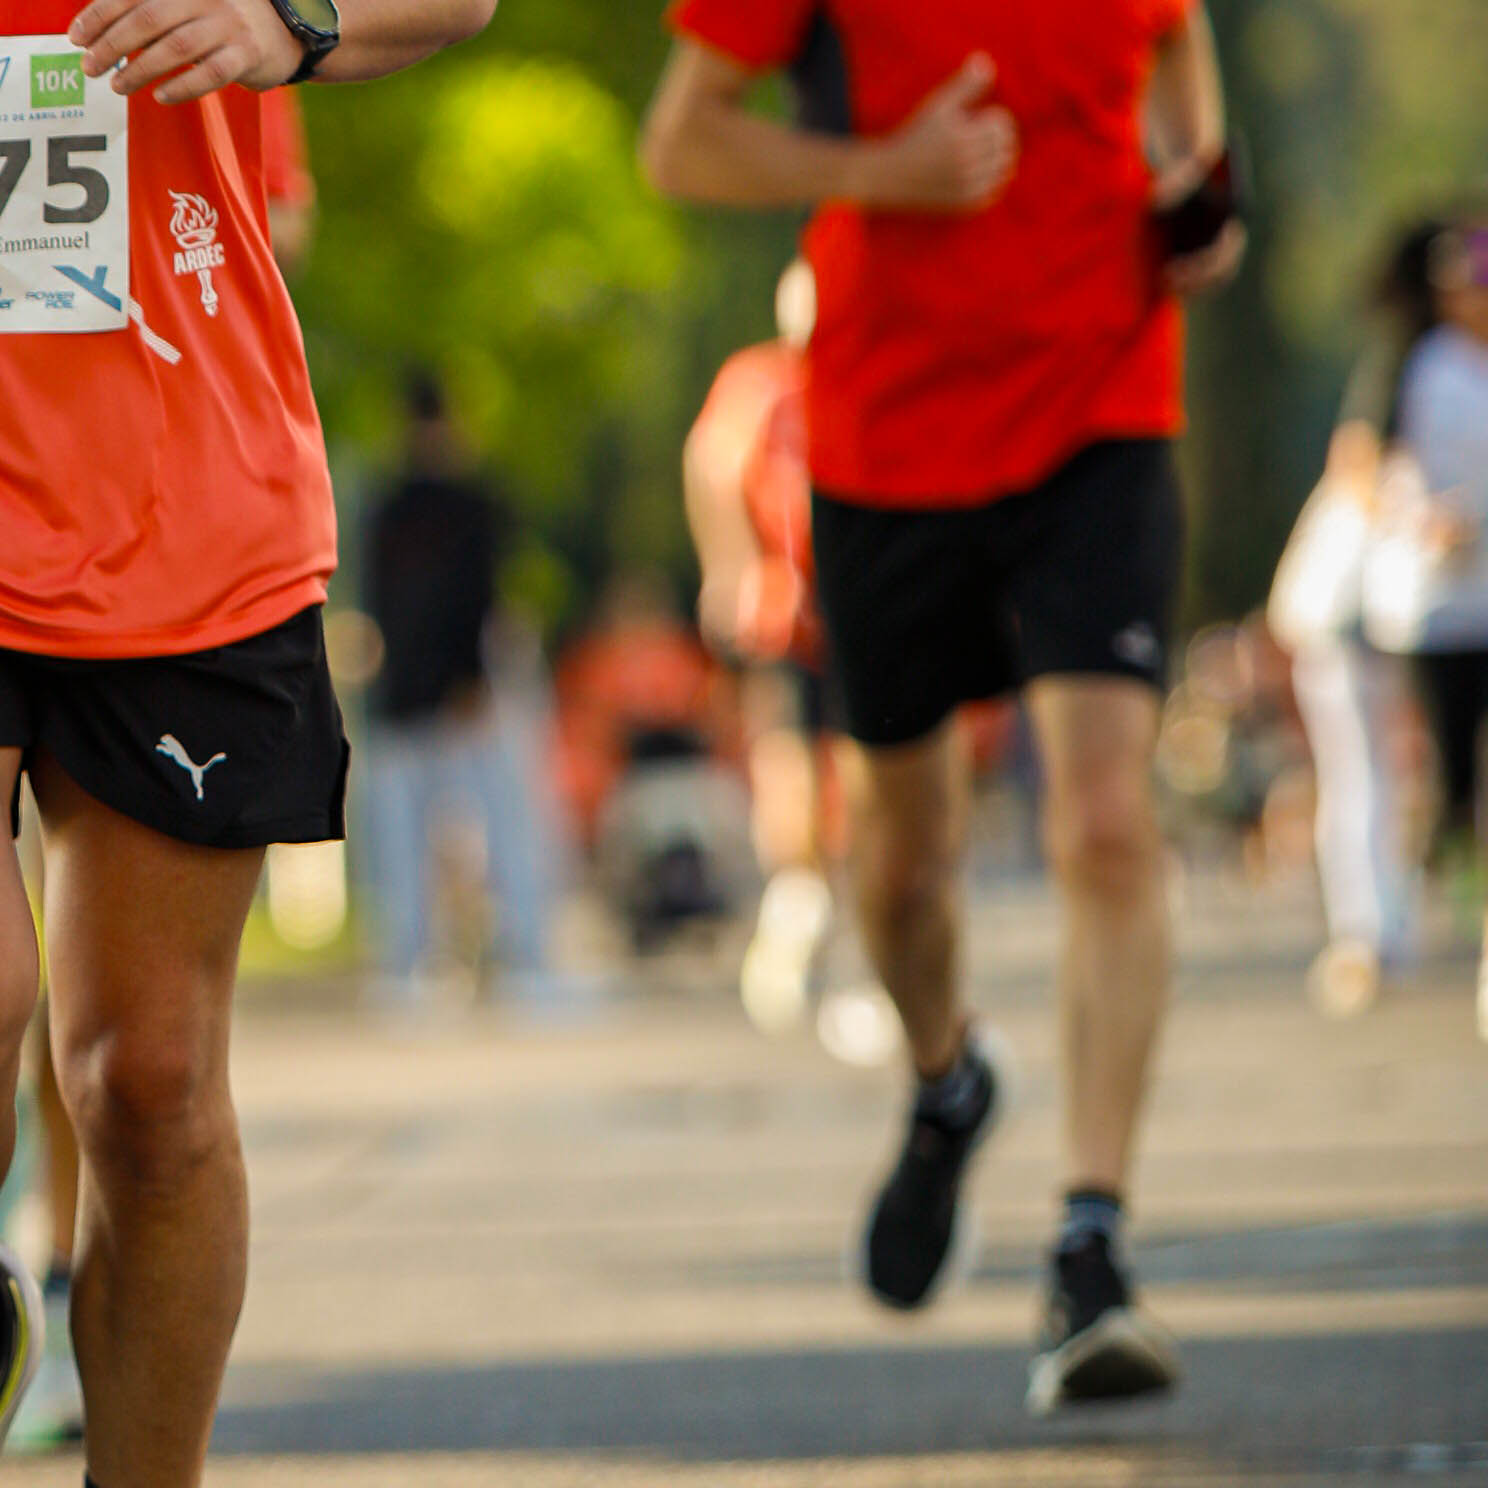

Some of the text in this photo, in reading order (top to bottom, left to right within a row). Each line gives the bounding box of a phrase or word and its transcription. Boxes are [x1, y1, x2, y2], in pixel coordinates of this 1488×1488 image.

[35, 69, 79, 92] 10K
[29, 111, 57, 120] ABRIL
[25, 291, 74, 301] POWER
